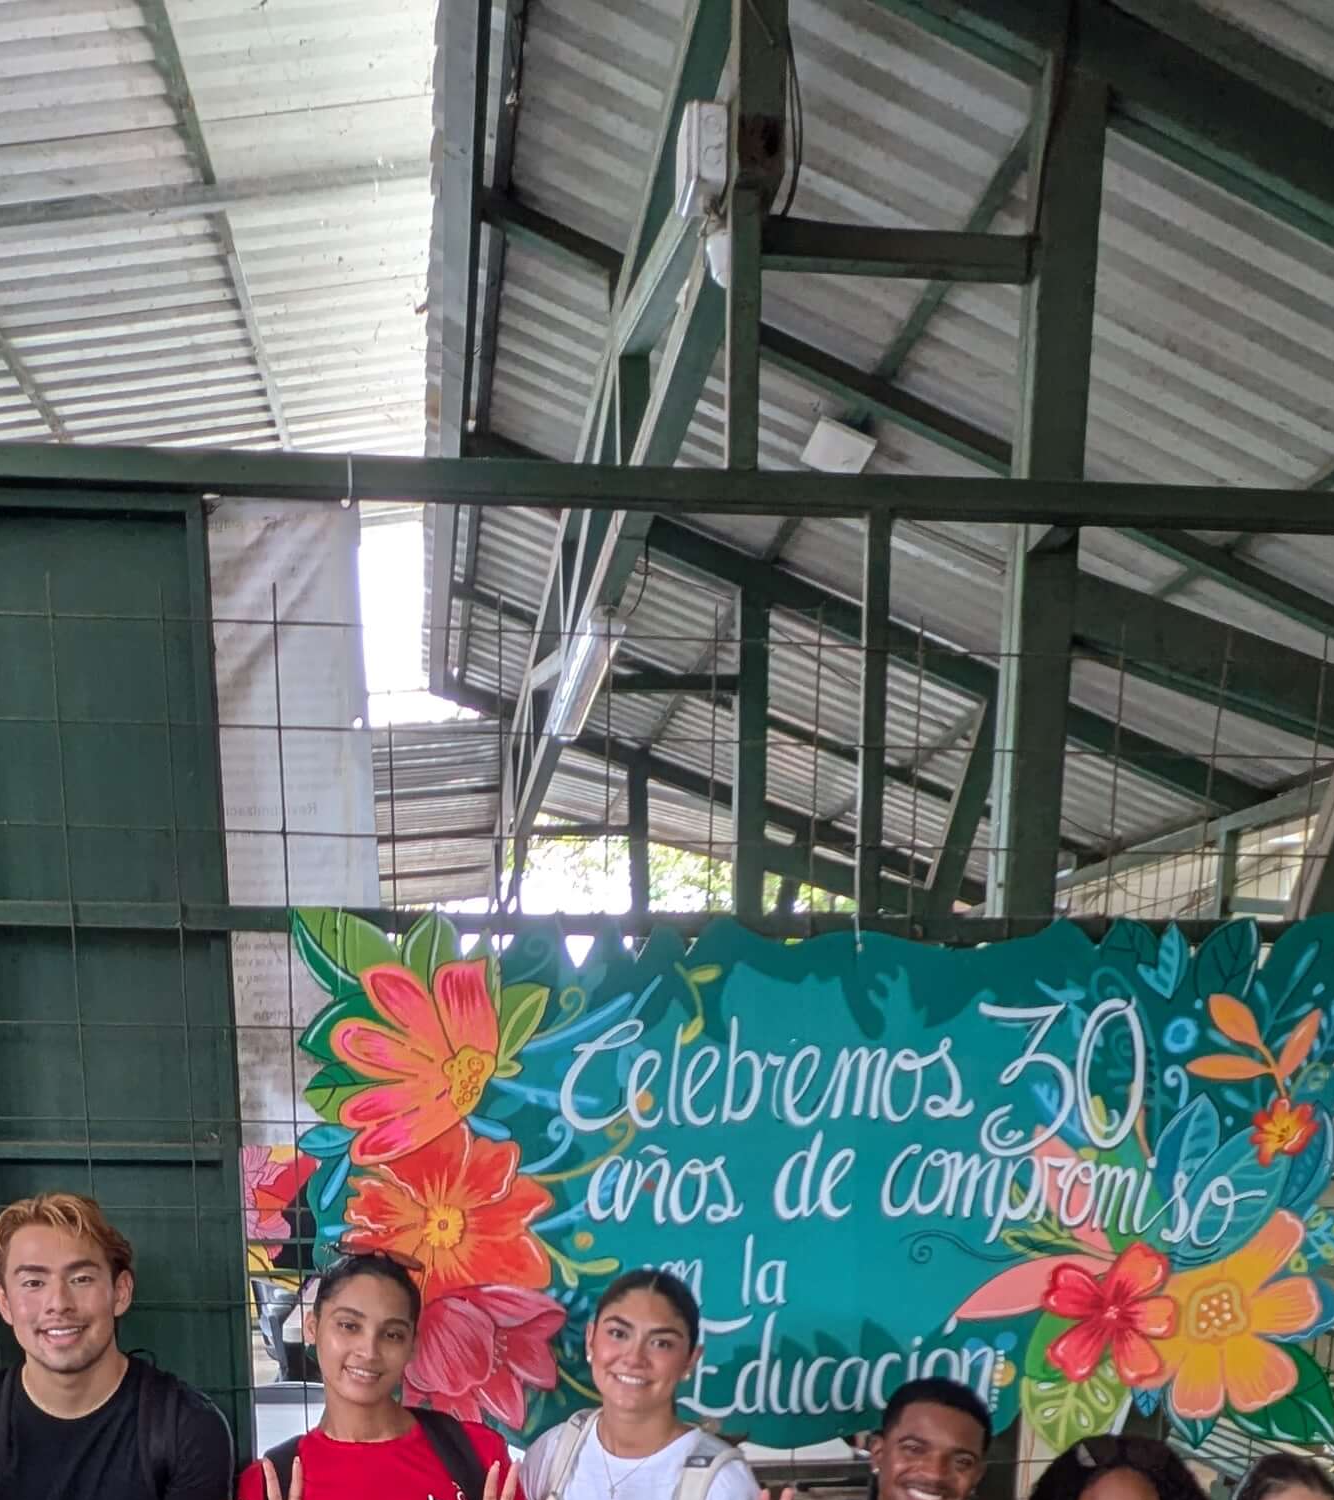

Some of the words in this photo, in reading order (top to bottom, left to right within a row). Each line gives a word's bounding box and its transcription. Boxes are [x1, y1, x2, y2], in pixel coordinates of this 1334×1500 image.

[559, 1014, 975, 1133] Celebremos
[978, 996, 1147, 1157] 30
[586, 1144, 744, 1224] años
[773, 1129, 857, 1220] de
[881, 1143, 1267, 1247] compromiso
[741, 1233, 788, 1307] la
